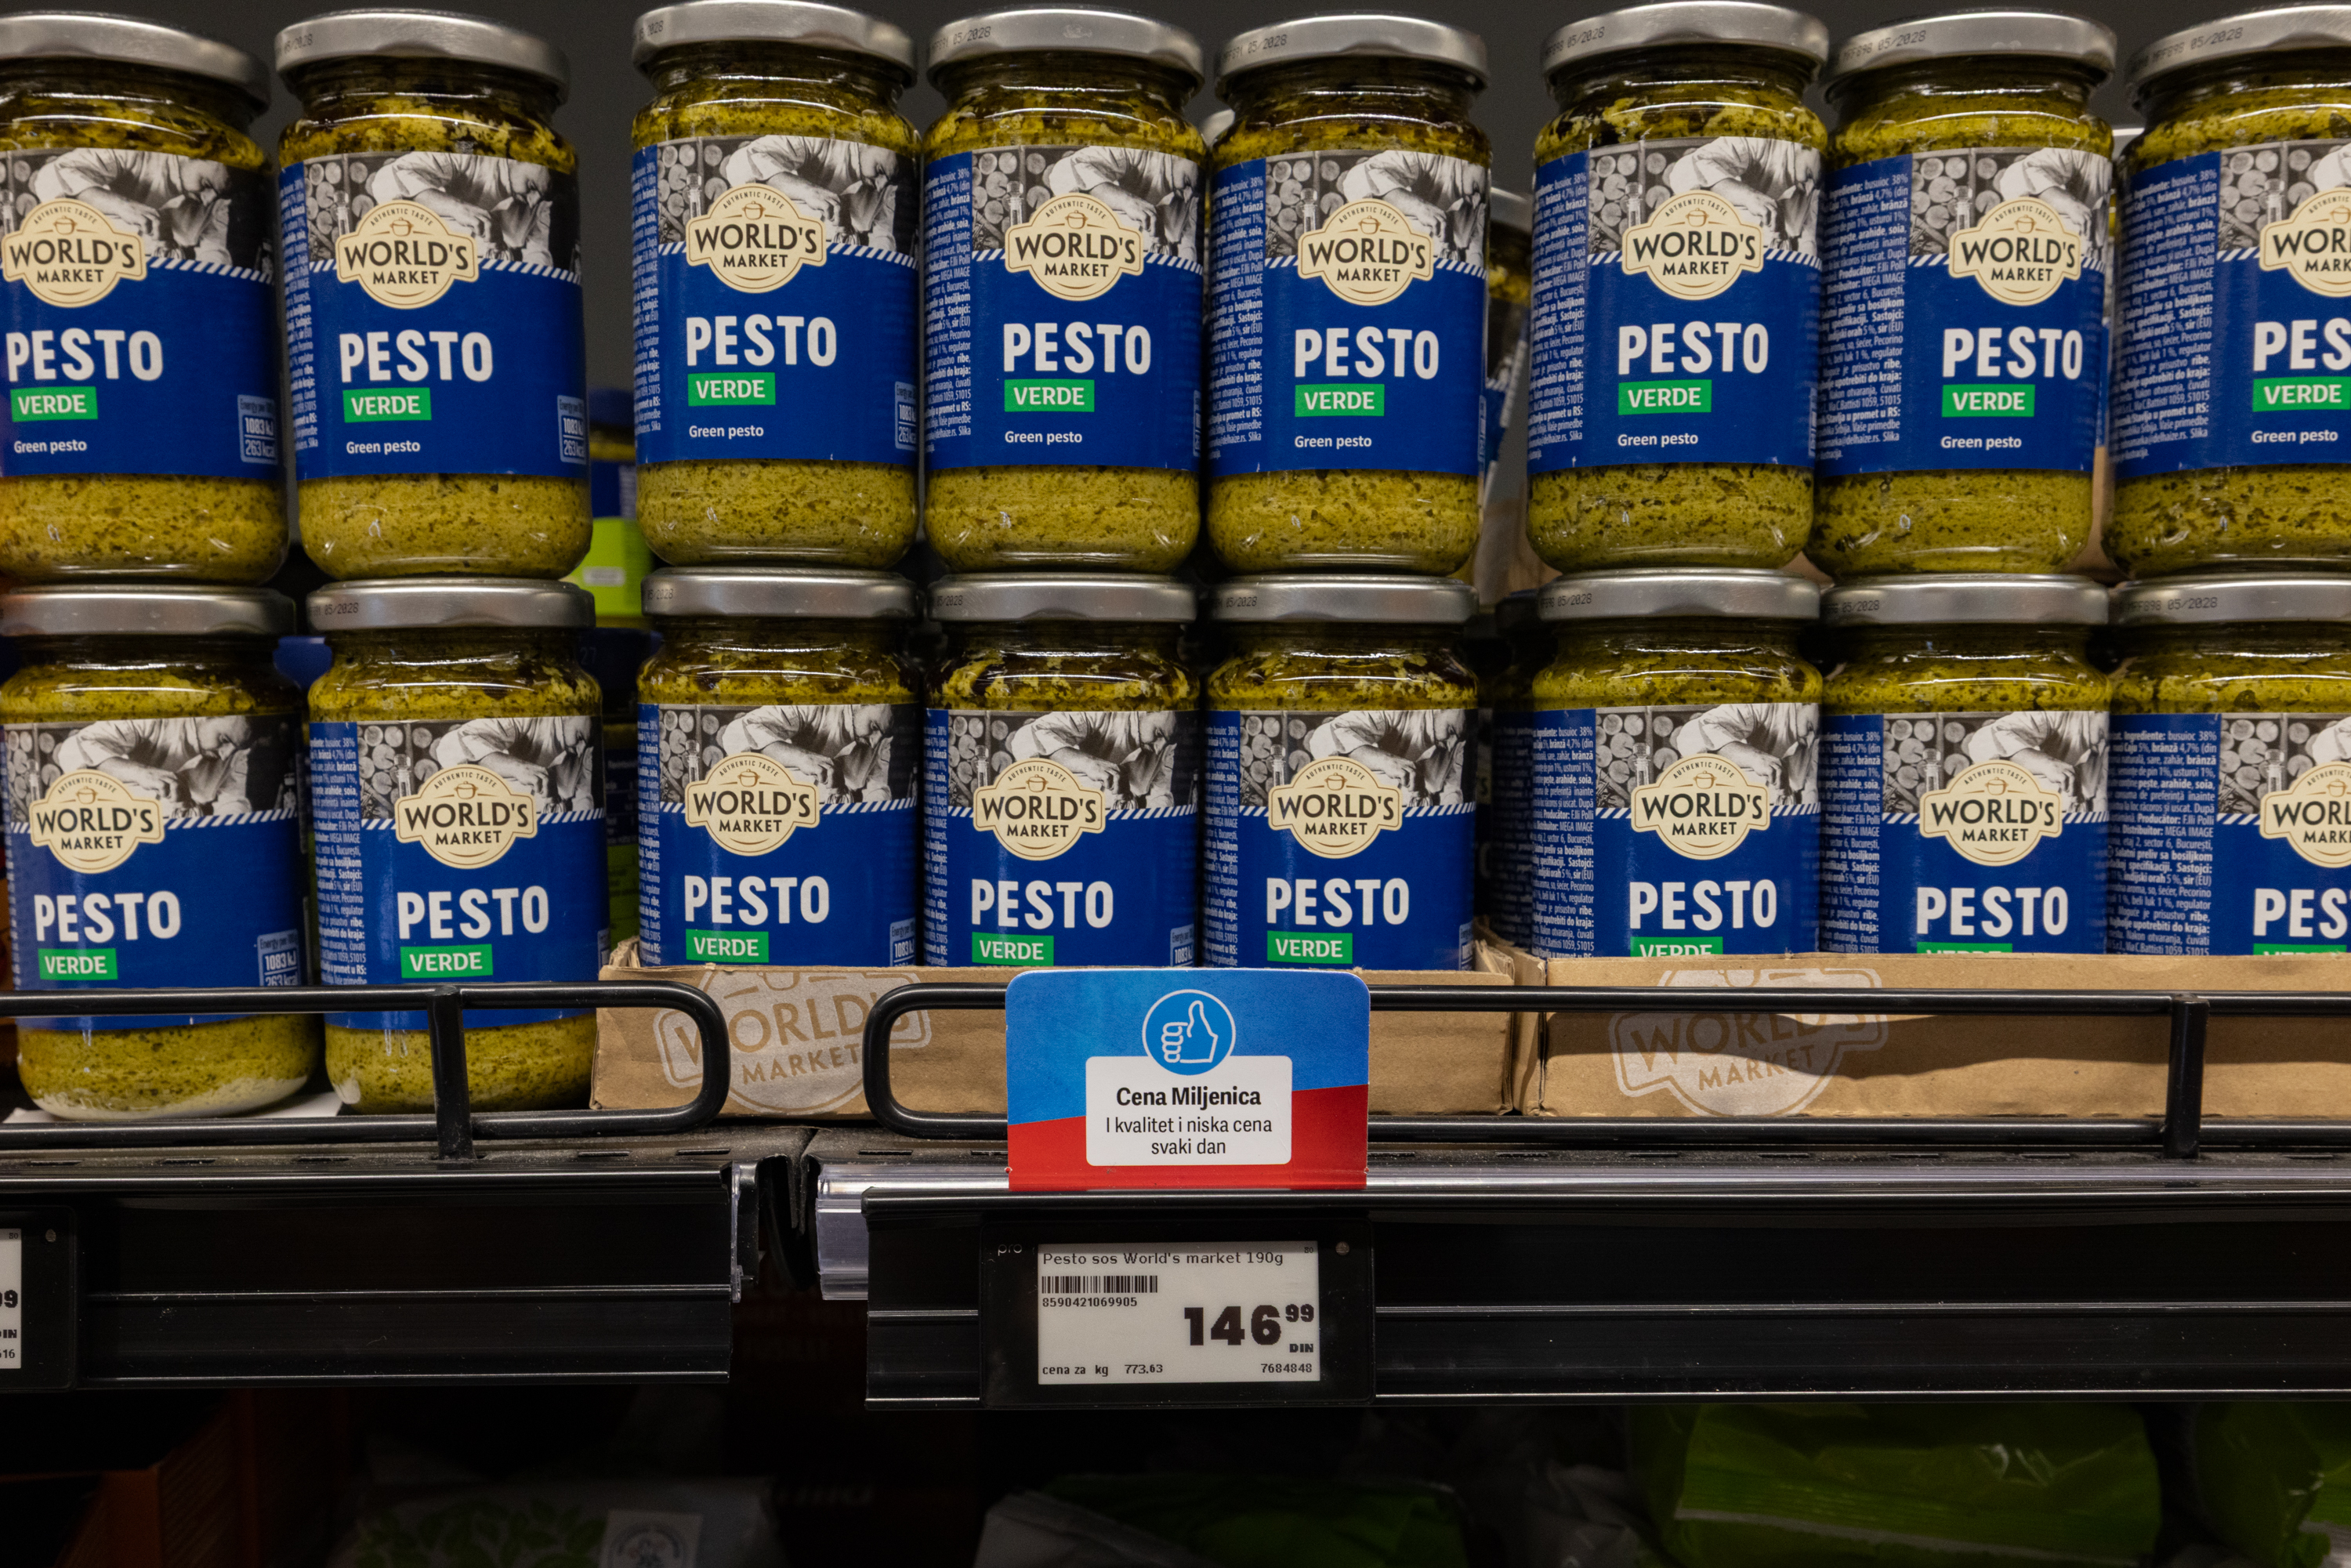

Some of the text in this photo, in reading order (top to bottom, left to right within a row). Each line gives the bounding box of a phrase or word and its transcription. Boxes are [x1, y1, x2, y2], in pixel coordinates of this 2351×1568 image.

[723, 191, 784, 209] AUTHENTIC TASTE
[1665, 198, 1728, 217] AUTHENTIC TASTE
[2309, 195, 2349, 214] AUTHENTIC
[34, 206, 97, 225] AUTHENTIC TASTE
[371, 208, 433, 226] AUTHENTIC TASTE
[1045, 201, 1107, 219] AUTHENTIC TASTE
[1339, 206, 1399, 224] AUTHENTIC TASTE
[1994, 205, 2053, 223] AUTHENTIC TASTE
[695, 224, 817, 253] WORLD'S
[1633, 231, 1755, 262] WORLD'S
[10, 239, 135, 268] WORLD'S
[345, 241, 468, 270] WORLD'S
[1016, 233, 1135, 263] WORLD'S
[1309, 238, 1425, 269] WORLD'S
[1962, 237, 2075, 268] WORLD'S
[723, 255, 788, 267] MARKET
[1045, 263, 1108, 277] MARKET
[1663, 262, 1729, 275] MARKET
[2304, 259, 2351, 272] MARK
[38, 270, 103, 282] MARKET
[373, 271, 438, 284] MARKET
[1337, 268, 1400, 281] MARKET
[1991, 268, 2052, 281] MARKET
[686, 314, 836, 366] PESTO
[1004, 322, 1150, 375] PESTO
[1619, 321, 1768, 375] PESTO
[2254, 317, 2351, 371] PES
[6, 328, 162, 382] PESTO
[339, 330, 492, 382] PESTO
[1295, 327, 1438, 379] PESTO
[1943, 327, 2082, 379] PESTO
[696, 380, 765, 398] VERDE
[1014, 387, 1084, 405] VERDE
[1628, 388, 1701, 407] VERDE
[2264, 385, 2342, 404] VERDE
[18, 395, 86, 415] VERDE
[351, 396, 421, 415] VERDE
[1304, 392, 1375, 410] VERDE
[1953, 393, 2025, 410] VERDE
[690, 425, 763, 439] Green pesto
[1005, 431, 1082, 445] Green pesto
[1618, 433, 1698, 447] Green pesto
[2251, 430, 2338, 444] Green pesto
[14, 440, 87, 454] Green pesto
[346, 440, 420, 454] Green pesto
[1295, 436, 1371, 449] Green pesto
[1941, 436, 2021, 450] Green pesto
[2168, 596, 2218, 610] 05/2028
[719, 759, 778, 777] AUTHENTIC TASTE
[1008, 766, 1067, 782] AUTHENTIC TASTE
[1306, 764, 1365, 780] AUTHENTIC TASTE
[1673, 762, 1734, 779] AUTHENTIC TASTE
[1964, 768, 2027, 784] AUTHENTIC TASTE
[57, 777, 116, 795] AUTHENTIC TASTE
[433, 772, 497, 790] AUTHENTIC TASTE
[2307, 770, 2345, 786] AUTHENTIC
[694, 791, 810, 817] WORLD'S
[982, 796, 1096, 823] WORLD'S
[1278, 794, 1393, 820] WORLD'S
[1642, 793, 1762, 820] WORLD'S
[1931, 799, 2054, 826] WORLD'S
[37, 808, 153, 834] WORLD'S
[405, 802, 528, 831] WORLD'S
[2273, 801, 2351, 827] WORL
[719, 820, 781, 831] MARKET
[1007, 824, 1068, 837] MARKET
[1305, 823, 1367, 835] MARKET
[1672, 822, 1737, 835] MARKET
[62, 836, 123, 849] MARKET
[436, 831, 502, 845] MARKET
[1962, 829, 2028, 841] MARKET
[2303, 831, 2351, 843] MARK
[685, 875, 829, 925] PESTO
[972, 879, 1113, 929] PESTO
[1267, 878, 1409, 927] PESTO
[1630, 879, 1777, 930] PESTO
[34, 891, 180, 943] PESTO
[397, 886, 549, 939] PESTO
[1917, 886, 2067, 937] PESTO
[2254, 888, 2348, 939] PES
[694, 937, 759, 956] VERDE
[980, 940, 1044, 960] VERDE
[1276, 939, 1342, 957] VERDE
[1639, 943, 1712, 958] VERDE
[45, 956, 107, 974] VERDE
[265, 952, 287, 972] 1083
[410, 952, 482, 972] VERDE
[741, 1042, 860, 1085] MARKET
[1698, 1044, 1816, 1092] MARKET
[1117, 1086, 1261, 1110] Cena Miljenica
[1107, 1117, 1272, 1132] I kvalitet i niska cena
[1152, 1139, 1225, 1154] svaki dan
[1042, 1251, 1284, 1266] Pesto sos World's market 190g
[0, 1290, 19, 1309] 9
[1043, 1298, 1137, 1306] 8590421069905
[1185, 1304, 1313, 1345] 146 99
[1290, 1344, 1313, 1353] DIN
[1096, 1365, 1108, 1377] kg
[1125, 1364, 1162, 1374] 773.63
[1261, 1363, 1312, 1373] 7684848
